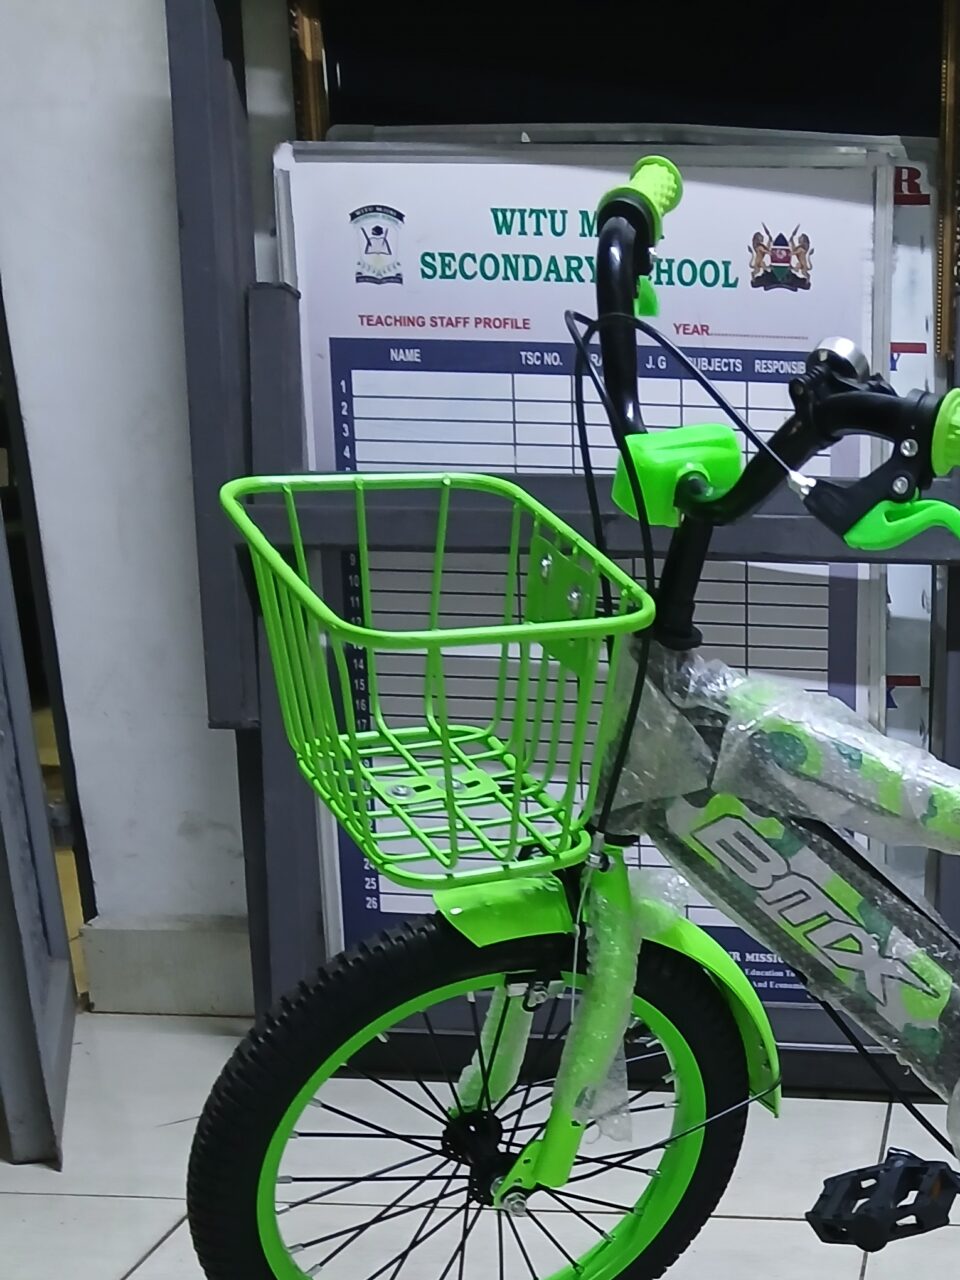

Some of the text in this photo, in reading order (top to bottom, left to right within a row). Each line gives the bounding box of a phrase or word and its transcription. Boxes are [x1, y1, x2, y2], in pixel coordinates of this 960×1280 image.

[490, 208, 568, 237] WITU
[647, 257, 739, 288] HOOL
[358, 315, 710, 336] TEACHING STAFF PROFILE YEAR
[389, 348, 421, 363] NAME
[520, 351, 541, 365] TSC
[543, 352, 563, 366] NO.
[754, 360, 805, 376] RESPONSIB
[339, 380, 347, 394] 1
[341, 401, 349, 415] 2
[342, 422, 350, 437] 3
[343, 445, 351, 460] 4
[348, 574, 360, 587] 10
[353, 658, 364, 670] 14
[354, 678, 365, 691] 15
[355, 699, 367, 711] 16
[364, 878, 377, 890] 25
[365, 897, 378, 910] 26
